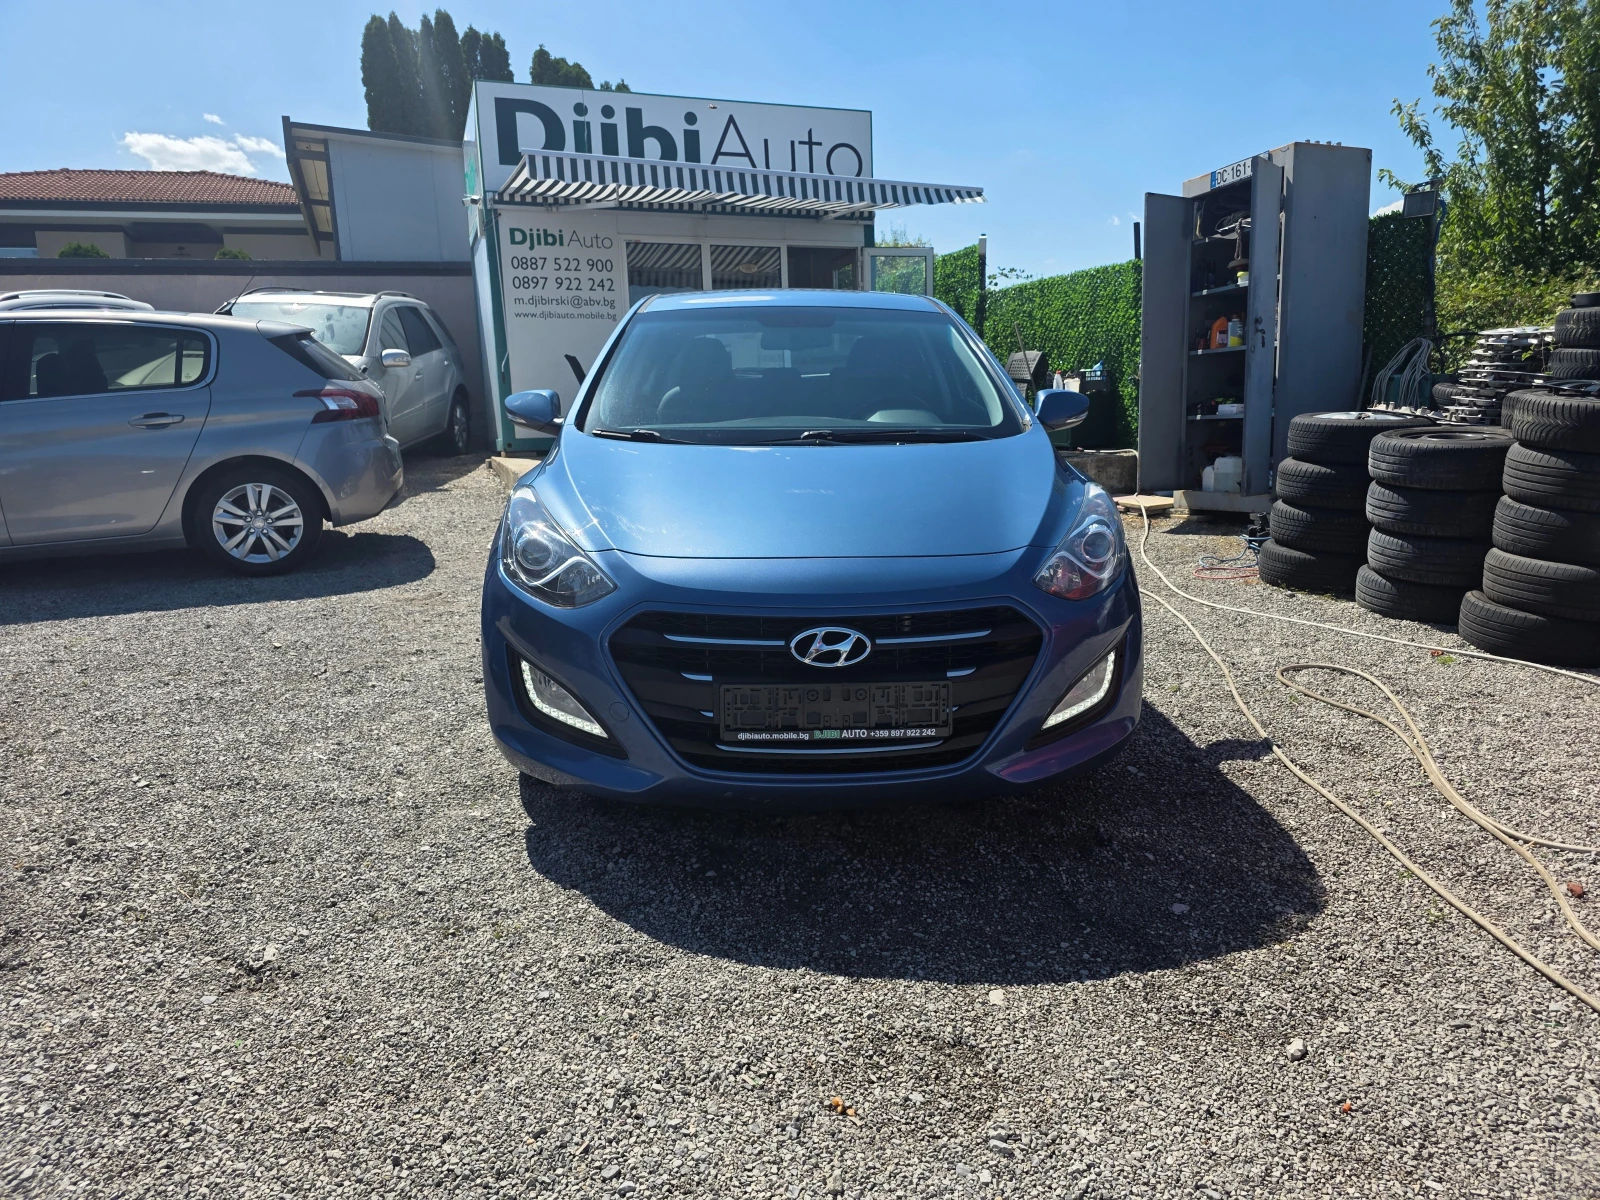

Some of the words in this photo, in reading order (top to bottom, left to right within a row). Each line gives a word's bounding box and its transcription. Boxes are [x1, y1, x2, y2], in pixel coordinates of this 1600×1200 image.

[509, 227, 564, 251] Djibi
[567, 230, 613, 249] Auto
[511, 256, 547, 270] 0887
[554, 257, 581, 271] 522
[587, 258, 613, 272] 900
[512, 276, 548, 290] 0897
[555, 277, 582, 291] 922
[588, 277, 615, 291] 242
[514, 295, 616, 309] m.djibirski@abv.bg
[514, 311, 617, 322] www.djibiauto.mobile.bg
[737, 732, 809, 740] djibiauto.mobile.bg
[813, 729, 840, 739] DJIBI
[841, 729, 867, 738] AUTO
[890, 729, 905, 737] 897
[922, 728, 936, 736] 242
